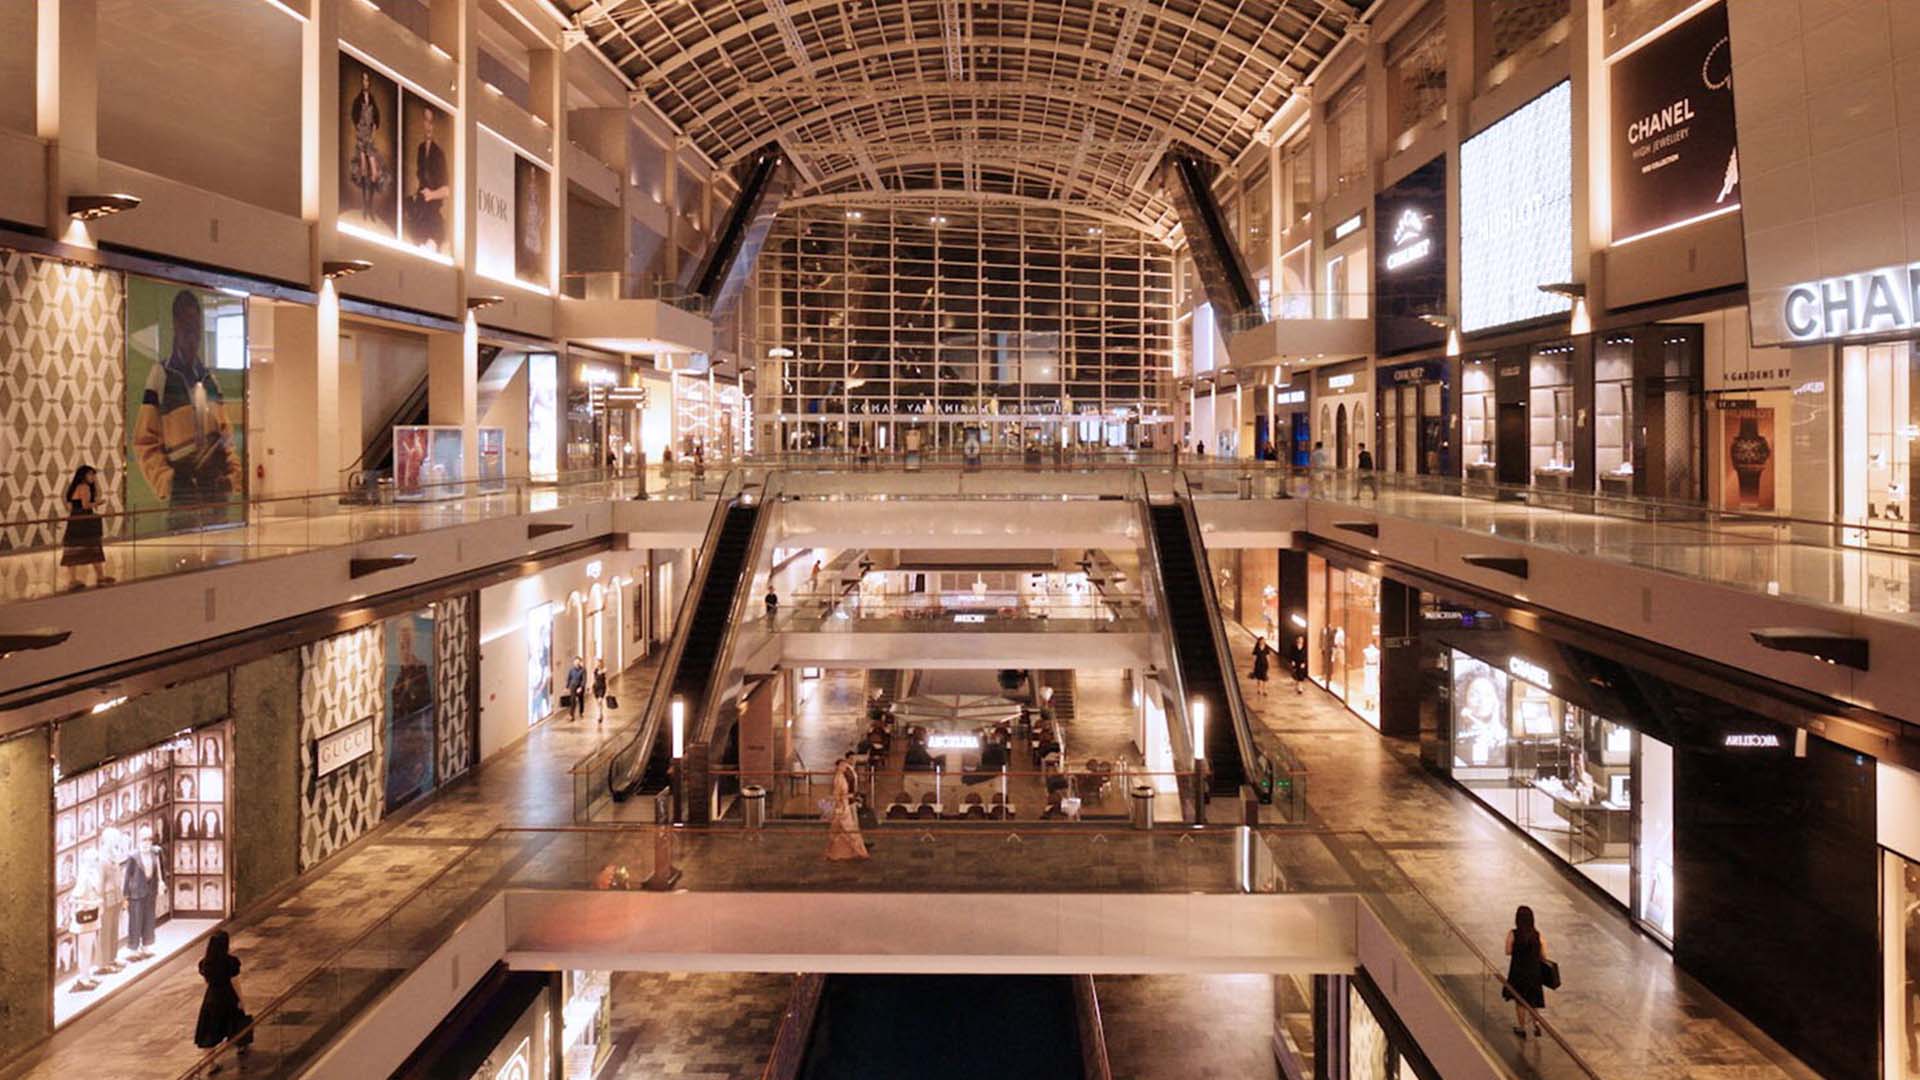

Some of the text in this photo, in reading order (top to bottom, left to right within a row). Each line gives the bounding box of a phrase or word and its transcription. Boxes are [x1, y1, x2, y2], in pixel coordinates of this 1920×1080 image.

[1628, 98, 1695, 145] CHANEL
[478, 189, 508, 222] DIOR
[1731, 369, 1774, 381] GARDENS
[1778, 368, 1791, 379] BY
[322, 728, 369, 764] GUCCI
